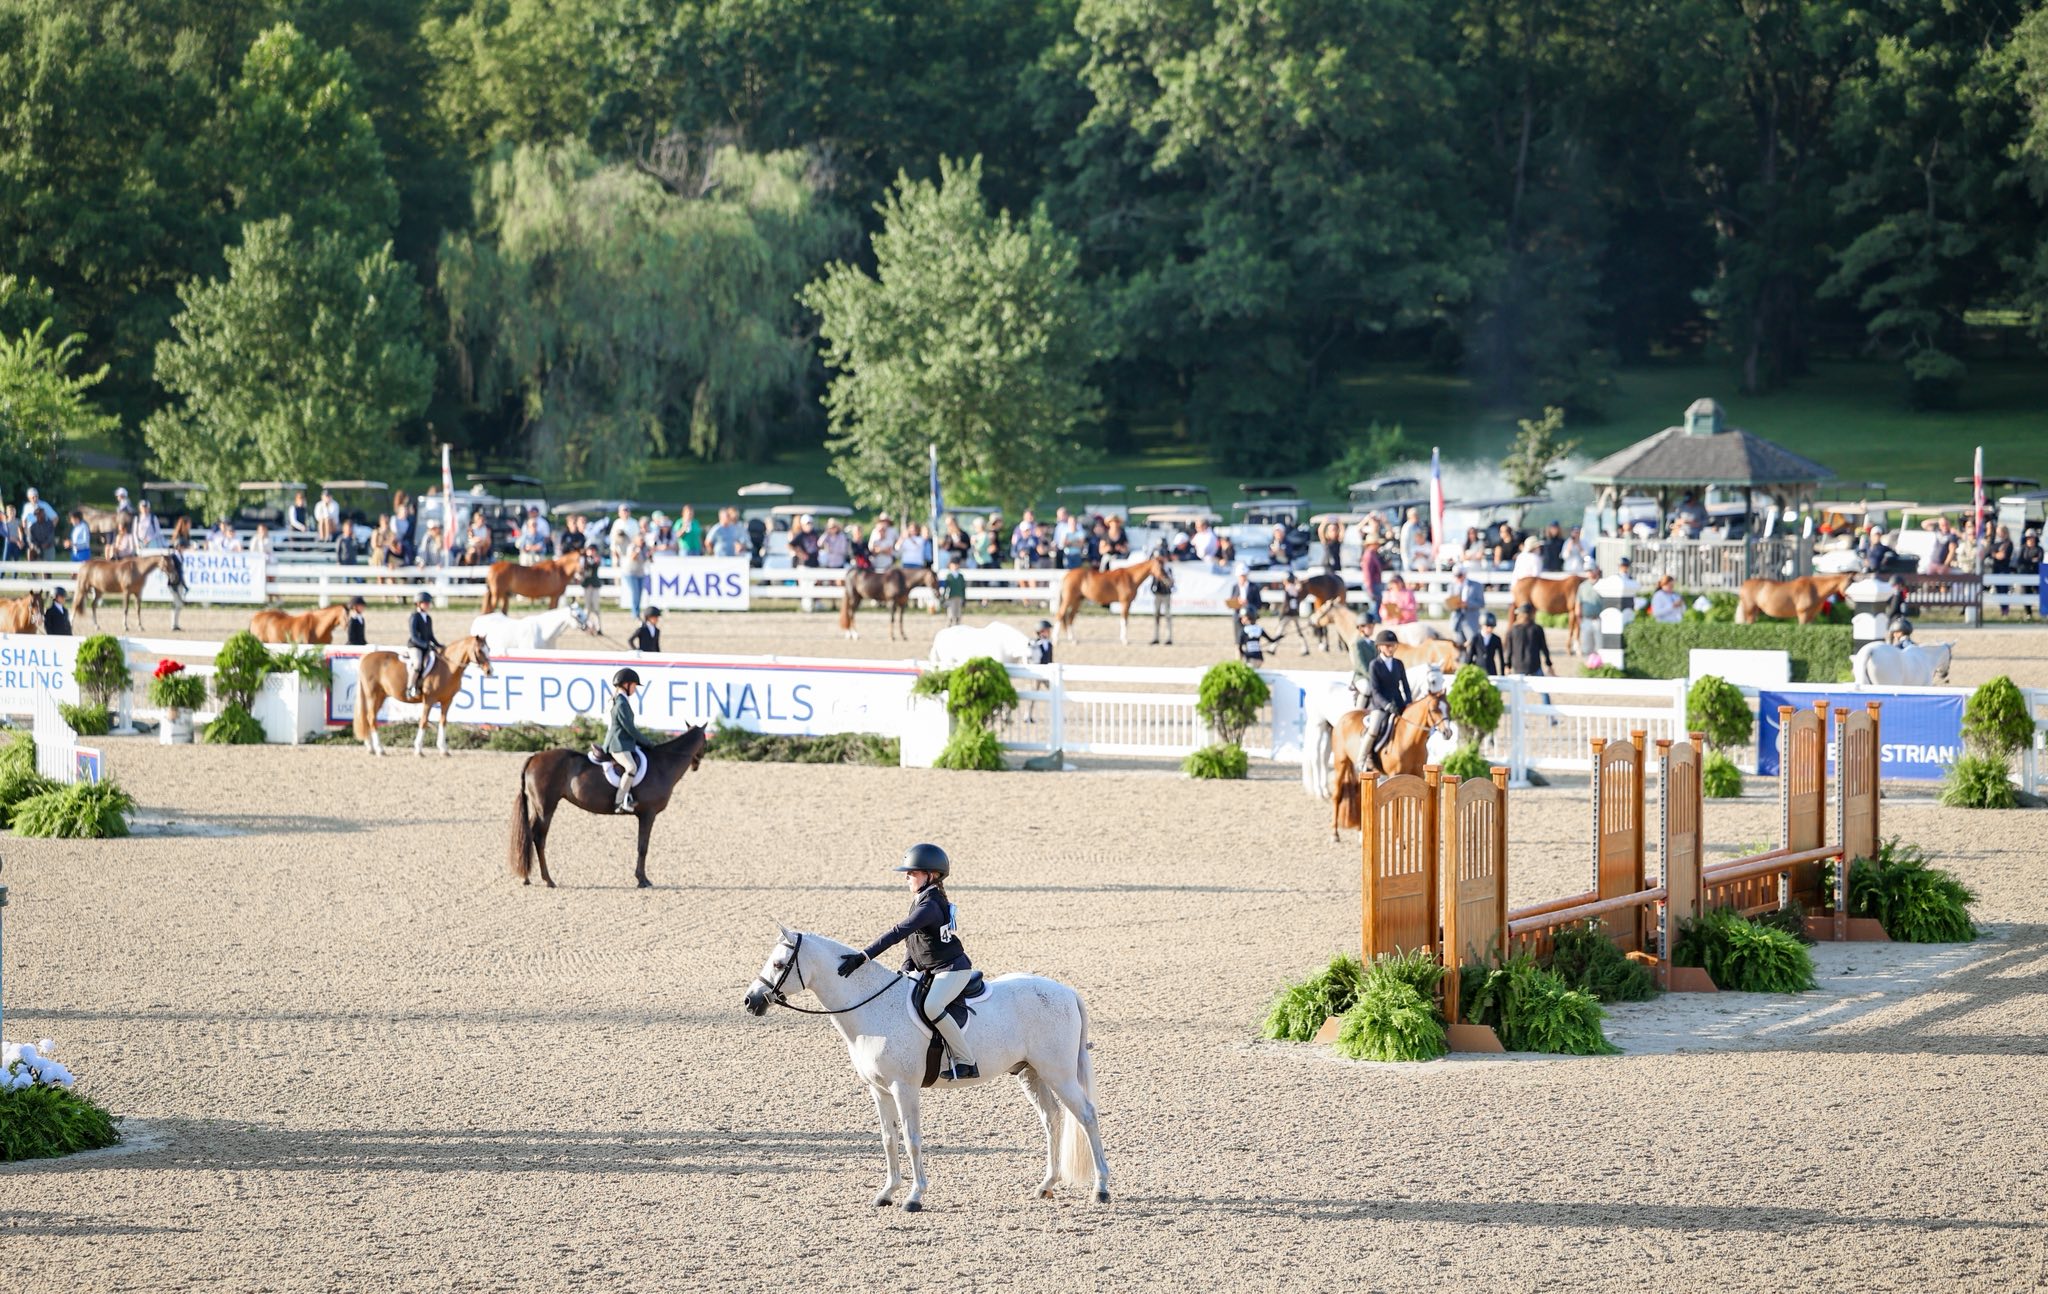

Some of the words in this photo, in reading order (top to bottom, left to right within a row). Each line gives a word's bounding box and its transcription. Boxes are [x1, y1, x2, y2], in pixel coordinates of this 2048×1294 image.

[185, 556, 249, 568] RSHALL
[189, 571, 252, 584] ERLING
[659, 573, 742, 597] MARS
[1, 648, 63, 667] SHALL
[0, 670, 63, 689] RLING
[432, 674, 524, 711] SEF
[669, 680, 814, 721] FINALS
[1827, 744, 1953, 763] ESTRIAN
